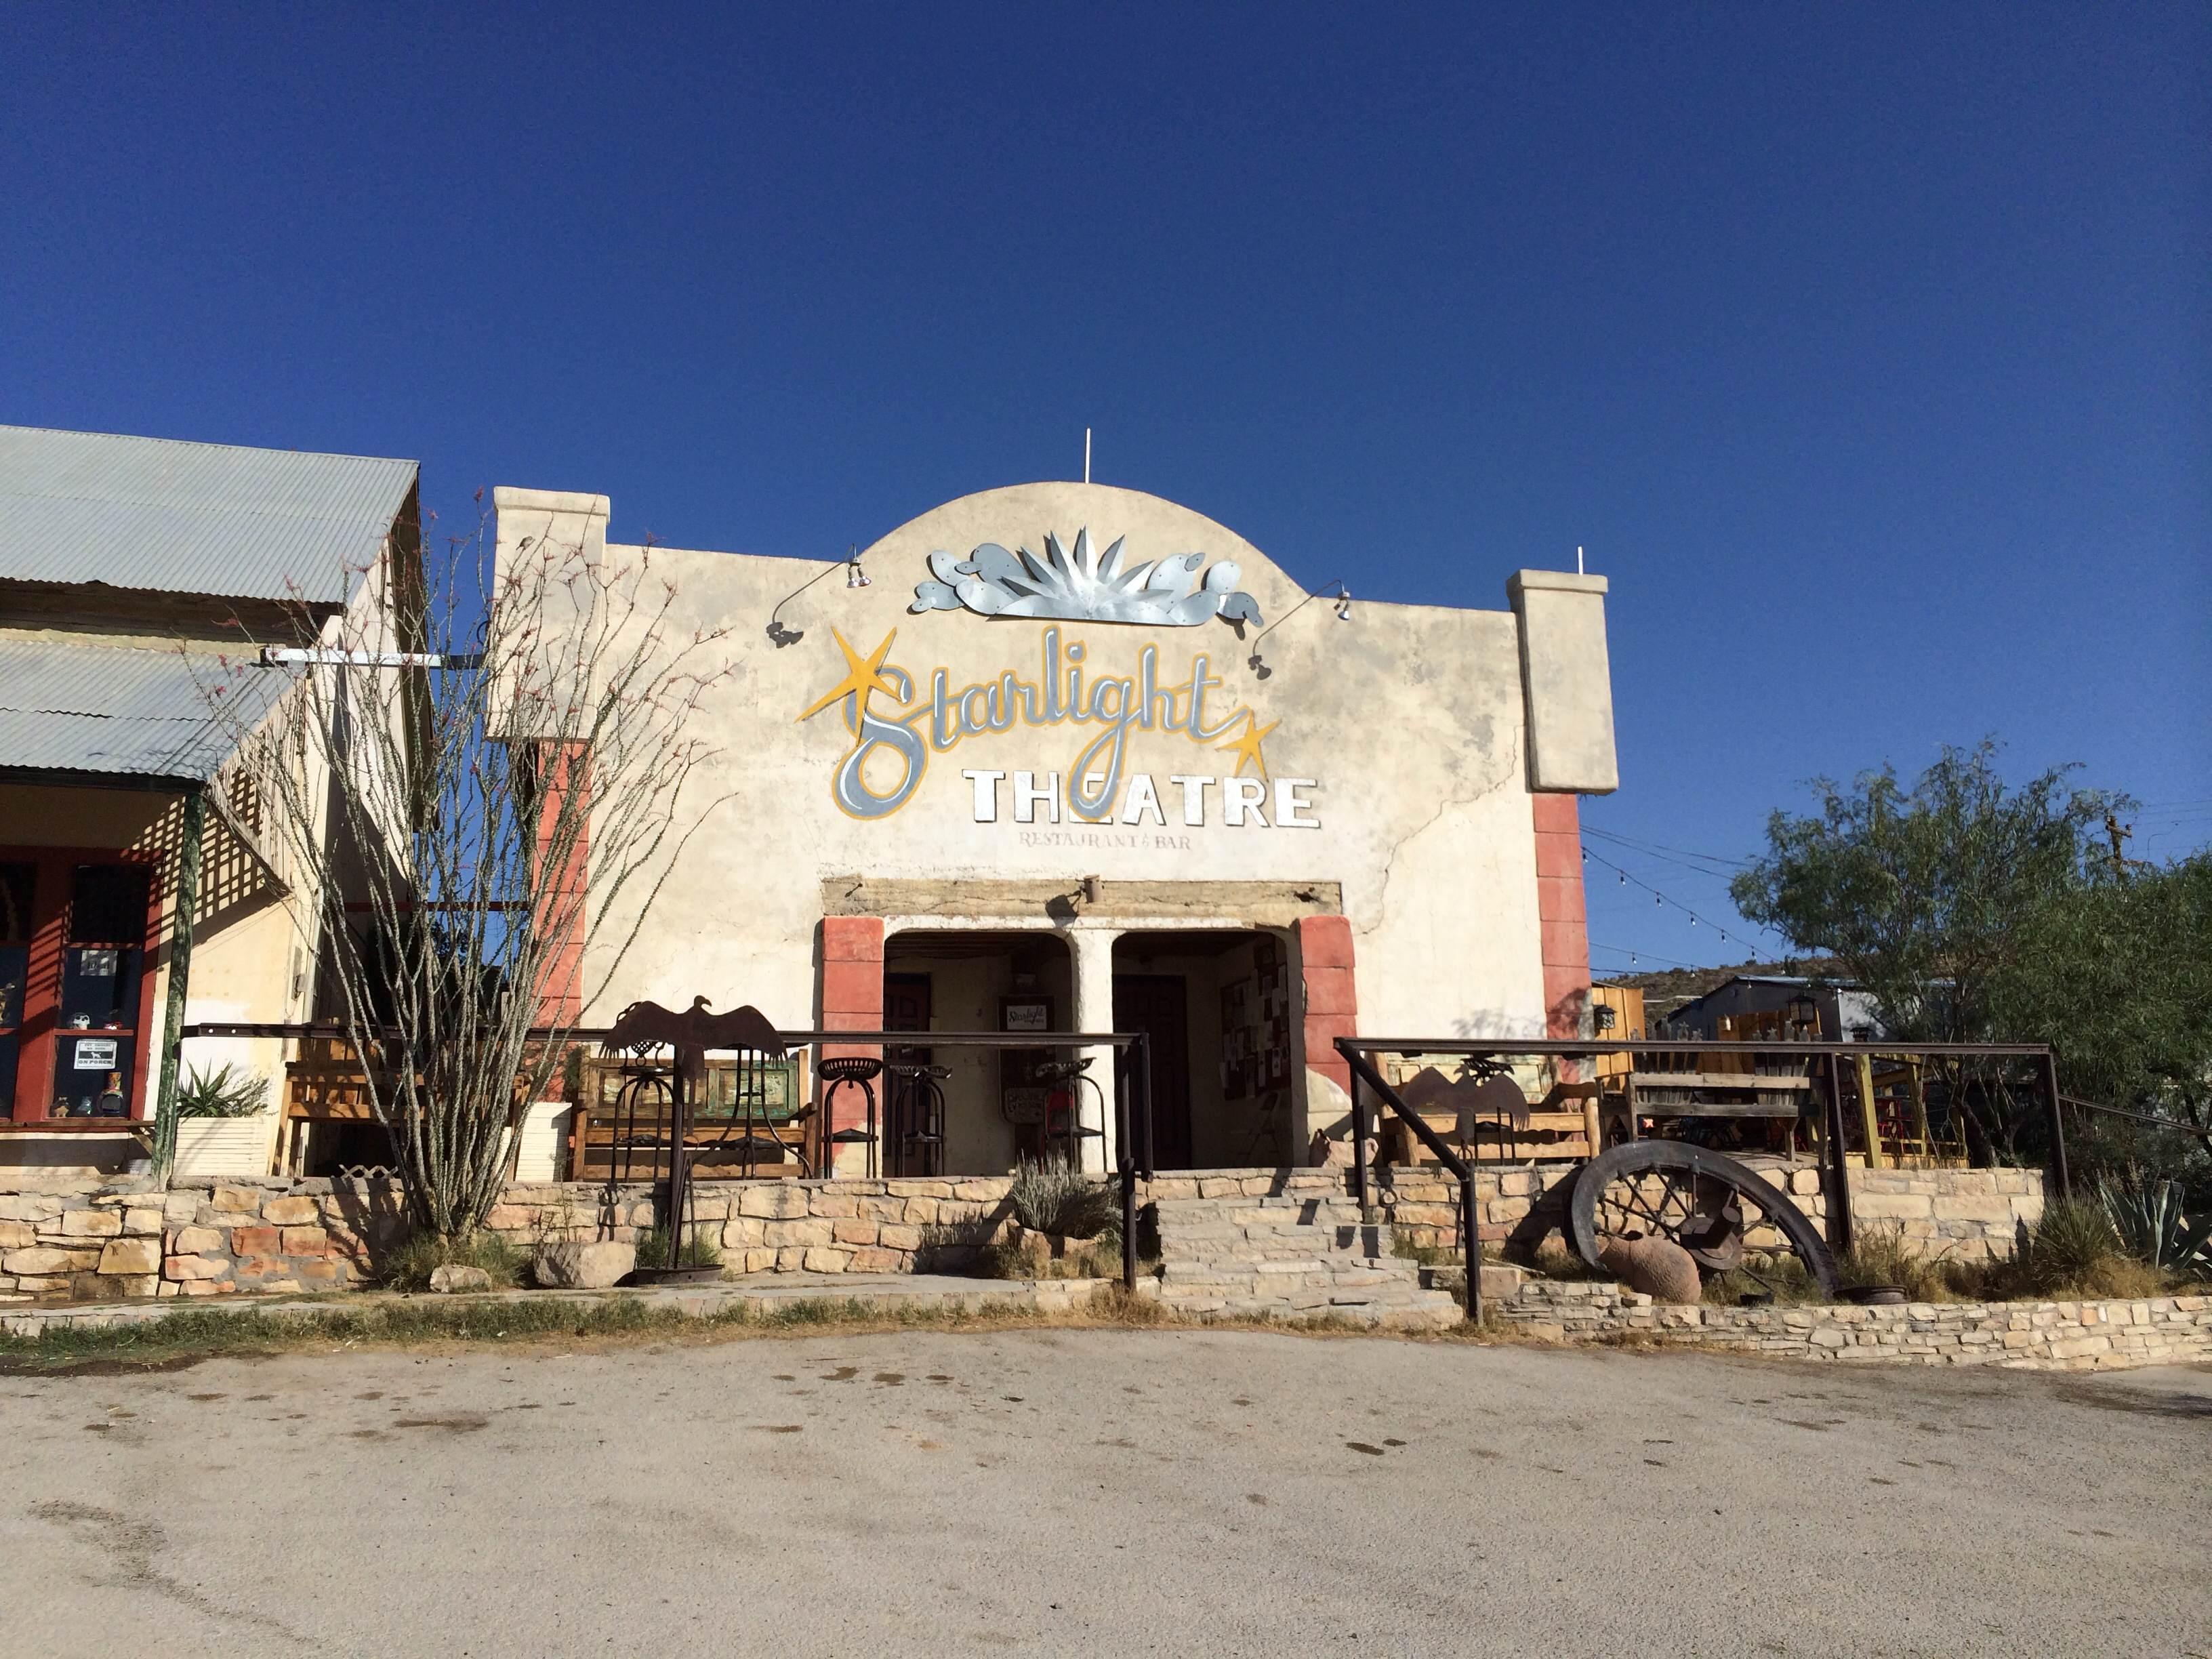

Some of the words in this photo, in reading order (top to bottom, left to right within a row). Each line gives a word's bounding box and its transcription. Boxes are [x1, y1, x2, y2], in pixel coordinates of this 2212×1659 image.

[832, 624, 1248, 821] Starlight
[962, 769, 1321, 830] THEATRE
[1154, 835, 1192, 851] BAR
